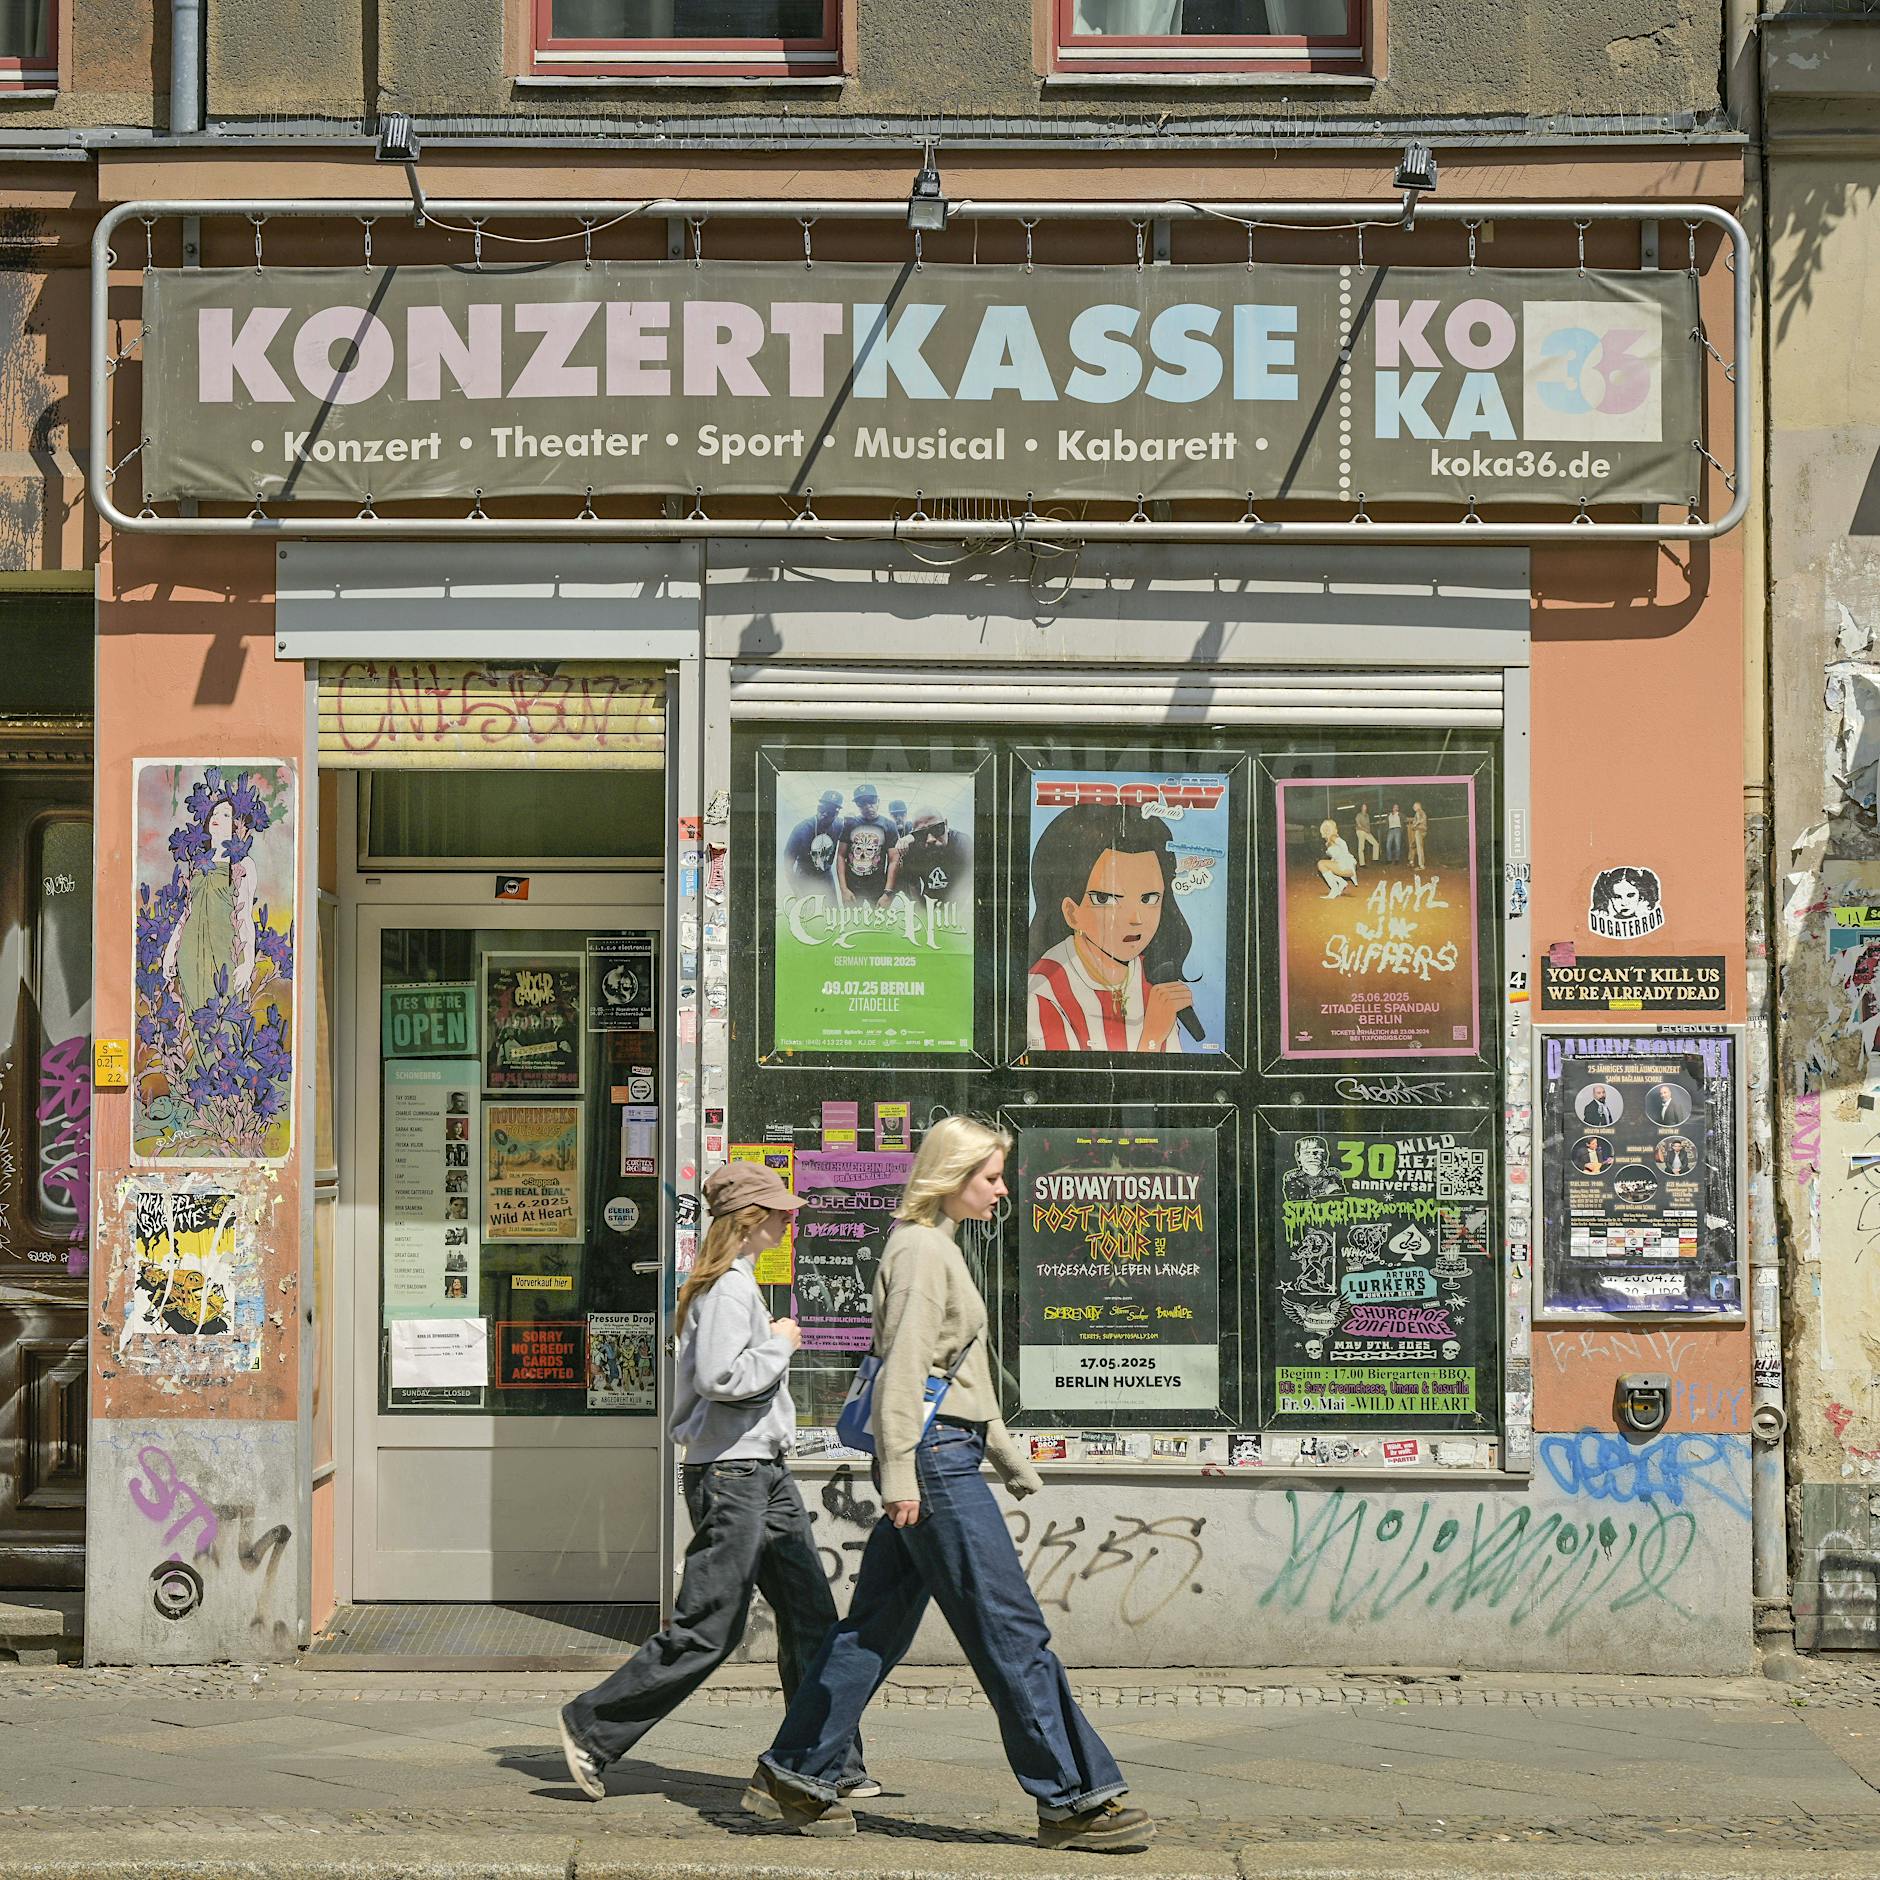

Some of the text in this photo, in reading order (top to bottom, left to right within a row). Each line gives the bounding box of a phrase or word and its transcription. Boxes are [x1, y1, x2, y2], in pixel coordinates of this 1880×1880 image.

[1375, 299, 1517, 370] KO
[199, 301, 1299, 405] KONZERTKASSE
[1536, 327, 1652, 415] 36
[1375, 371, 1518, 441] KA
[284, 424, 1237, 464] Konzert Theater Sport Musical Kabarett
[1431, 449, 1611, 479] koka36.de
[1367, 874, 1449, 914] AMYL
[782, 891, 967, 949] Cypress Hill
[1590, 907, 1663, 937] DOGATERROR
[834, 956, 916, 967] GERMANY TOUR 2025
[1322, 934, 1458, 981] SNIFFERS
[1547, 968, 1586, 982] YOU
[1650, 968, 1693, 982] KILL
[1697, 968, 1720, 982] US
[823, 981, 925, 995] 09.07.25 BERLIN
[1602, 986, 1675, 1000] ALREADY
[1676, 986, 1720, 1000] DEAD
[396, 995, 462, 1010] YES WE'RE
[849, 998, 900, 1011] ZITADELLE
[1351, 993, 1409, 1002] 25.06.2025
[1320, 1002, 1440, 1014] ZITADELLE SPANDAU
[1359, 1014, 1402, 1024] BERLIN
[393, 1013, 466, 1047] OPEN
[107, 1073, 121, 1083] 2.2
[1396, 1133, 1456, 1154] WILD
[1337, 1141, 1396, 1180] 30
[515, 1187, 538, 1196] REAL
[1352, 1179, 1435, 1192] anniversar
[494, 1197, 569, 1210] 14.6.2025
[806, 1195, 897, 1209] OFFENDE
[490, 1206, 573, 1226] Wild At Heart
[608, 1207, 635, 1215] BLEIBT
[1033, 1202, 1203, 1234] POST MORTEM
[1282, 1196, 1377, 1230] SLAUGHTER
[1084, 1230, 1152, 1262] TOUR
[798, 1256, 854, 1265] 24.05.2025
[1036, 1262, 1200, 1277] TOTGESAGTE LEBEN LÄNGER
[515, 1277, 568, 1287] Vorverkauf hier
[1349, 1277, 1426, 1292] LURKERS
[589, 1314, 655, 1325] Pressure Drop
[1352, 1306, 1448, 1322] CHURCH OF
[1343, 1319, 1456, 1336] CONFIDENCE
[522, 1331, 564, 1342] SORRY
[511, 1343, 575, 1354] NO CREDIT
[1334, 1341, 1362, 1350] MAY
[1398, 1341, 1431, 1350] 2025
[522, 1355, 563, 1367] CARDS
[1080, 1358, 1156, 1370] 17.05.2025
[512, 1367, 574, 1379] ACCEPTED
[1281, 1369, 1321, 1381] Beginn
[1333, 1369, 1364, 1379] 17.00
[1055, 1376, 1182, 1388] BERLIN HUXLEYS
[1304, 1381, 1326, 1397] Suzy
[1328, 1381, 1387, 1396] Creamcheese,
[1390, 1381, 1419, 1394] Umann
[1421, 1382, 1429, 1394] &
[402, 1389, 471, 1397] SUNDAY CLOSED
[1281, 1398, 1299, 1411] Fr.
[1303, 1398, 1315, 1411] 9.
[1319, 1398, 1345, 1411] Mai
[1398, 1398, 1417, 1411] AT
[1420, 1397, 1470, 1410] HEART
[1037, 1440, 1058, 1448] DROP
